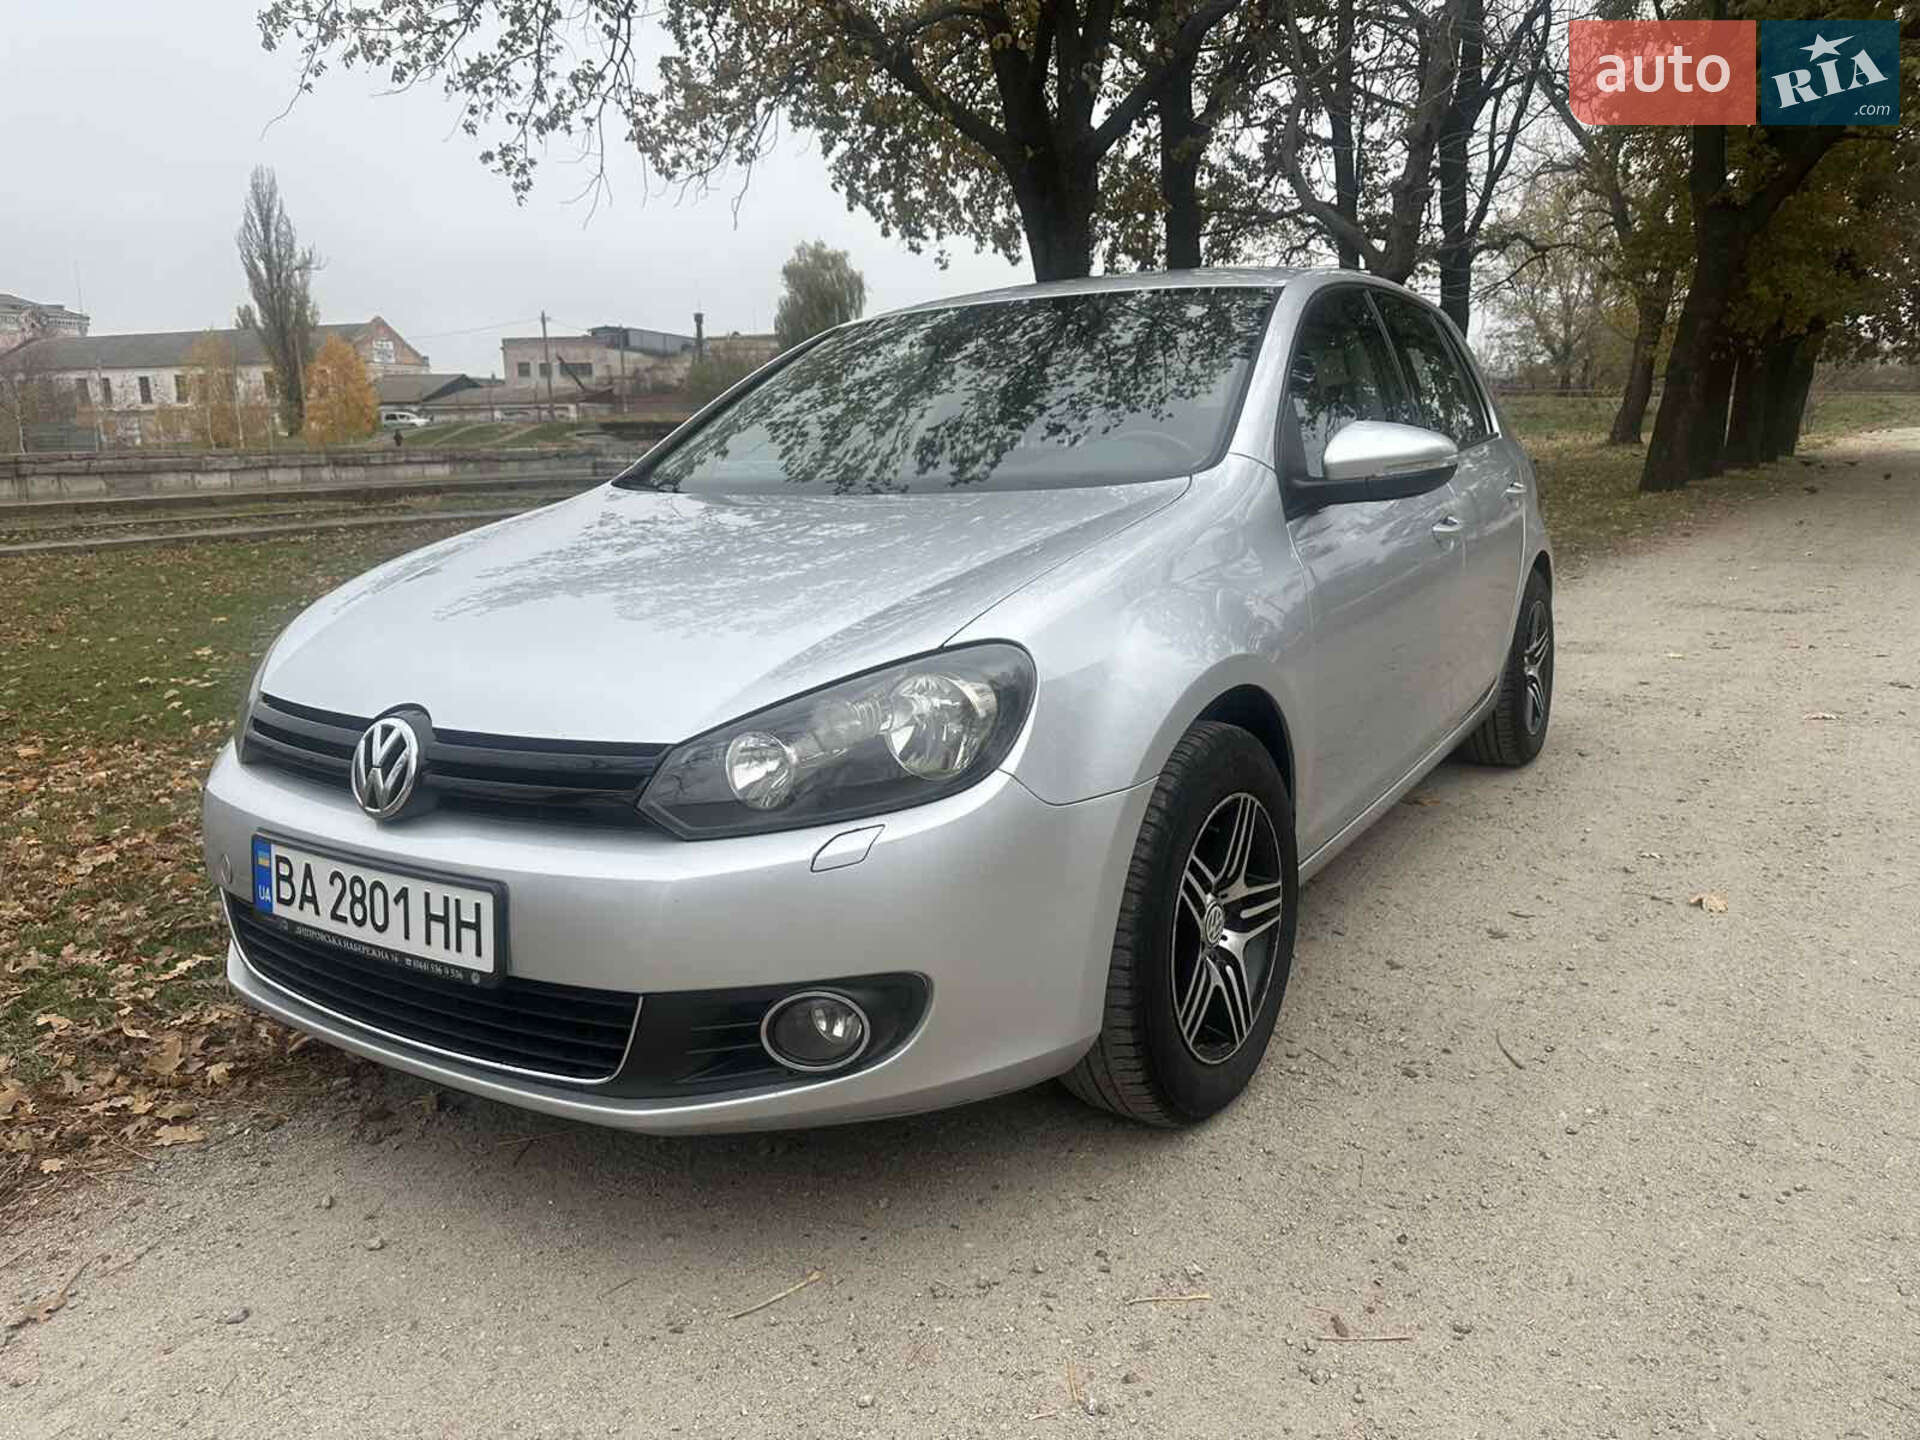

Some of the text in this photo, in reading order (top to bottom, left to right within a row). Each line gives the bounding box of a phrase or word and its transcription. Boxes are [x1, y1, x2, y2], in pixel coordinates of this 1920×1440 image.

[258, 885, 272, 902] UA
[275, 854, 482, 958] BA 2801 HH
